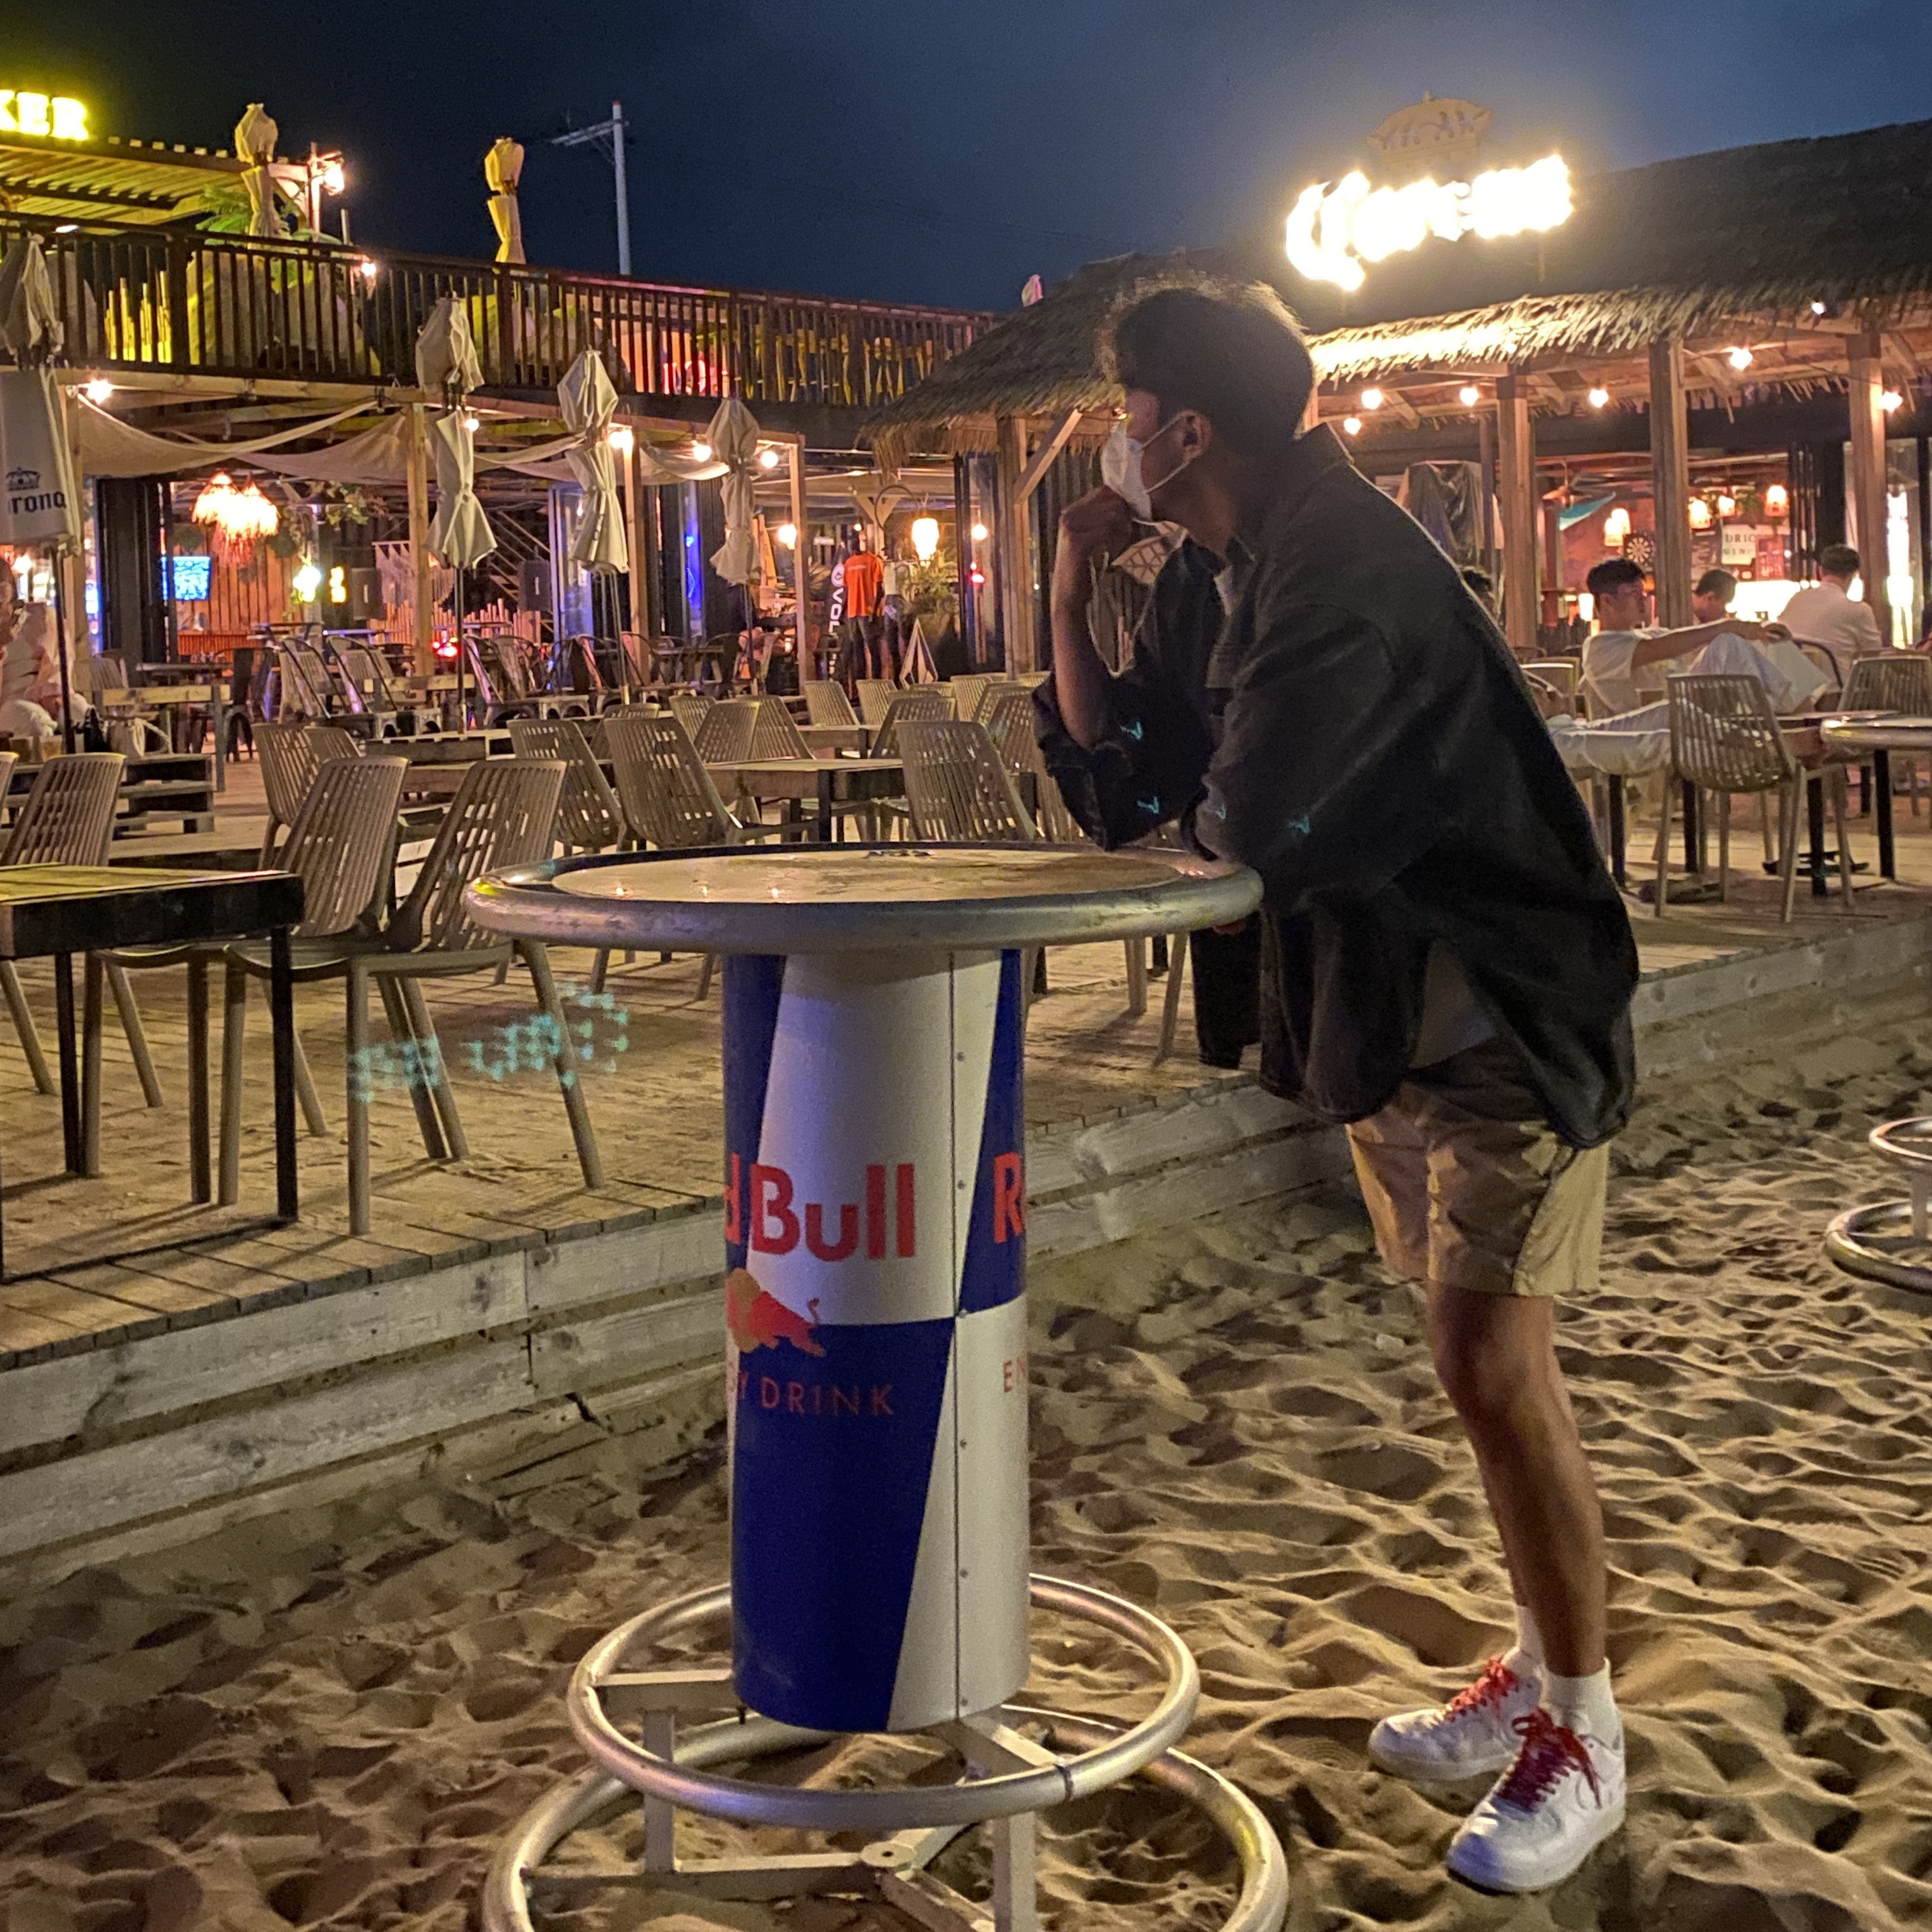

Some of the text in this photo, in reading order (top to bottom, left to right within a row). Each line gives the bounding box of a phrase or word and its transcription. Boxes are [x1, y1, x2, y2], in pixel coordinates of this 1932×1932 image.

[8, 491, 66, 514] rona
[750, 1163, 916, 1262] Bull
[761, 1376, 894, 1416] DRINK
